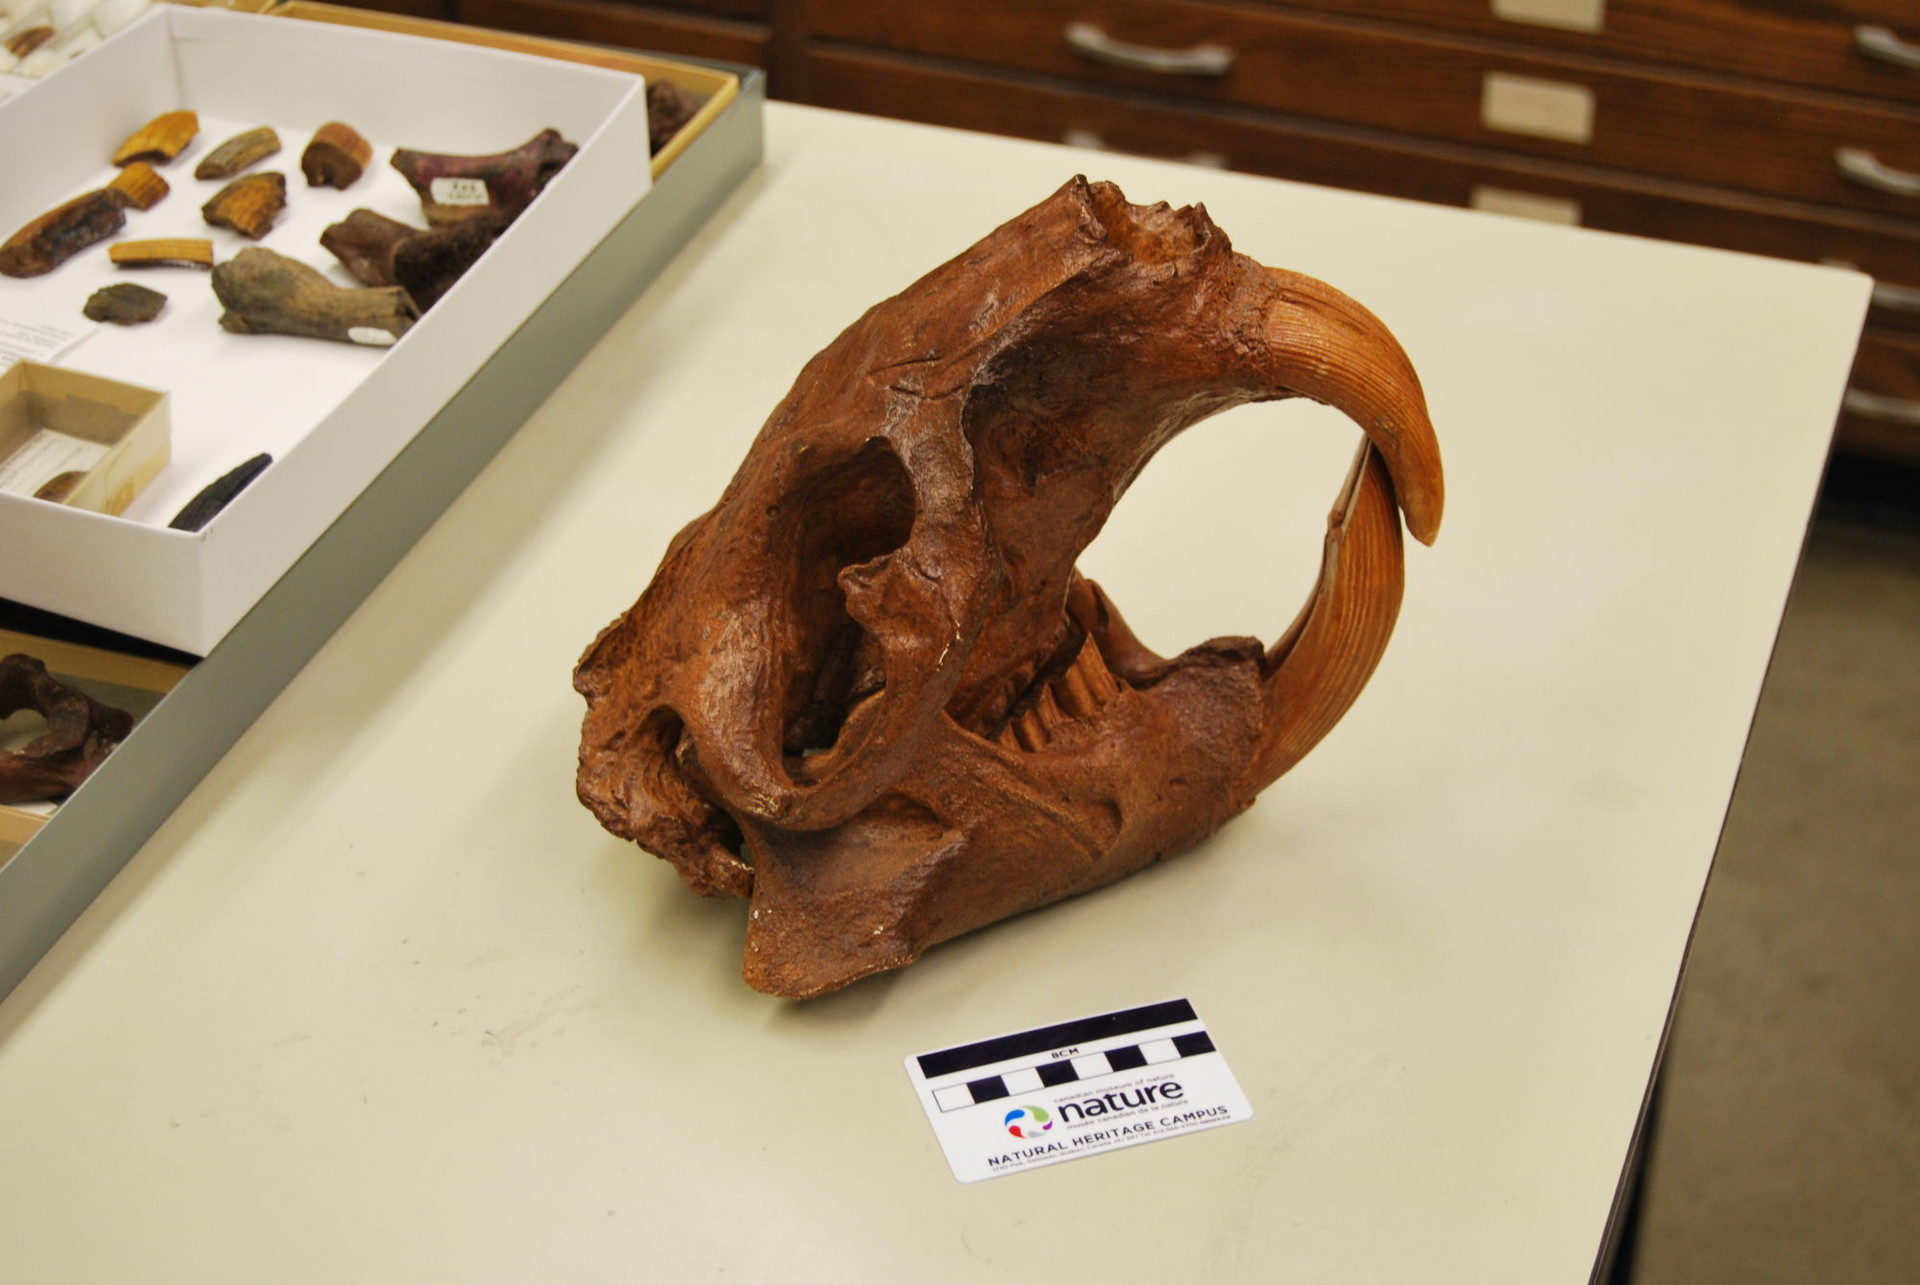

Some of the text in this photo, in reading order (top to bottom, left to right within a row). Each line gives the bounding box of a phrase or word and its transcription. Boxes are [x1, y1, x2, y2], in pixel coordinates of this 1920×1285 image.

[1095, 1082, 1132, 1094] museum
[1134, 1078, 1144, 1086] of
[1146, 1073, 1175, 1083] nature
[1057, 1081, 1183, 1122] nature
[1160, 1099, 1188, 1108] nature
[988, 1141, 1067, 1166] NATURAL
[1071, 1121, 1154, 1146] HERITAGE
[1159, 1105, 1227, 1127] CAMPUS
